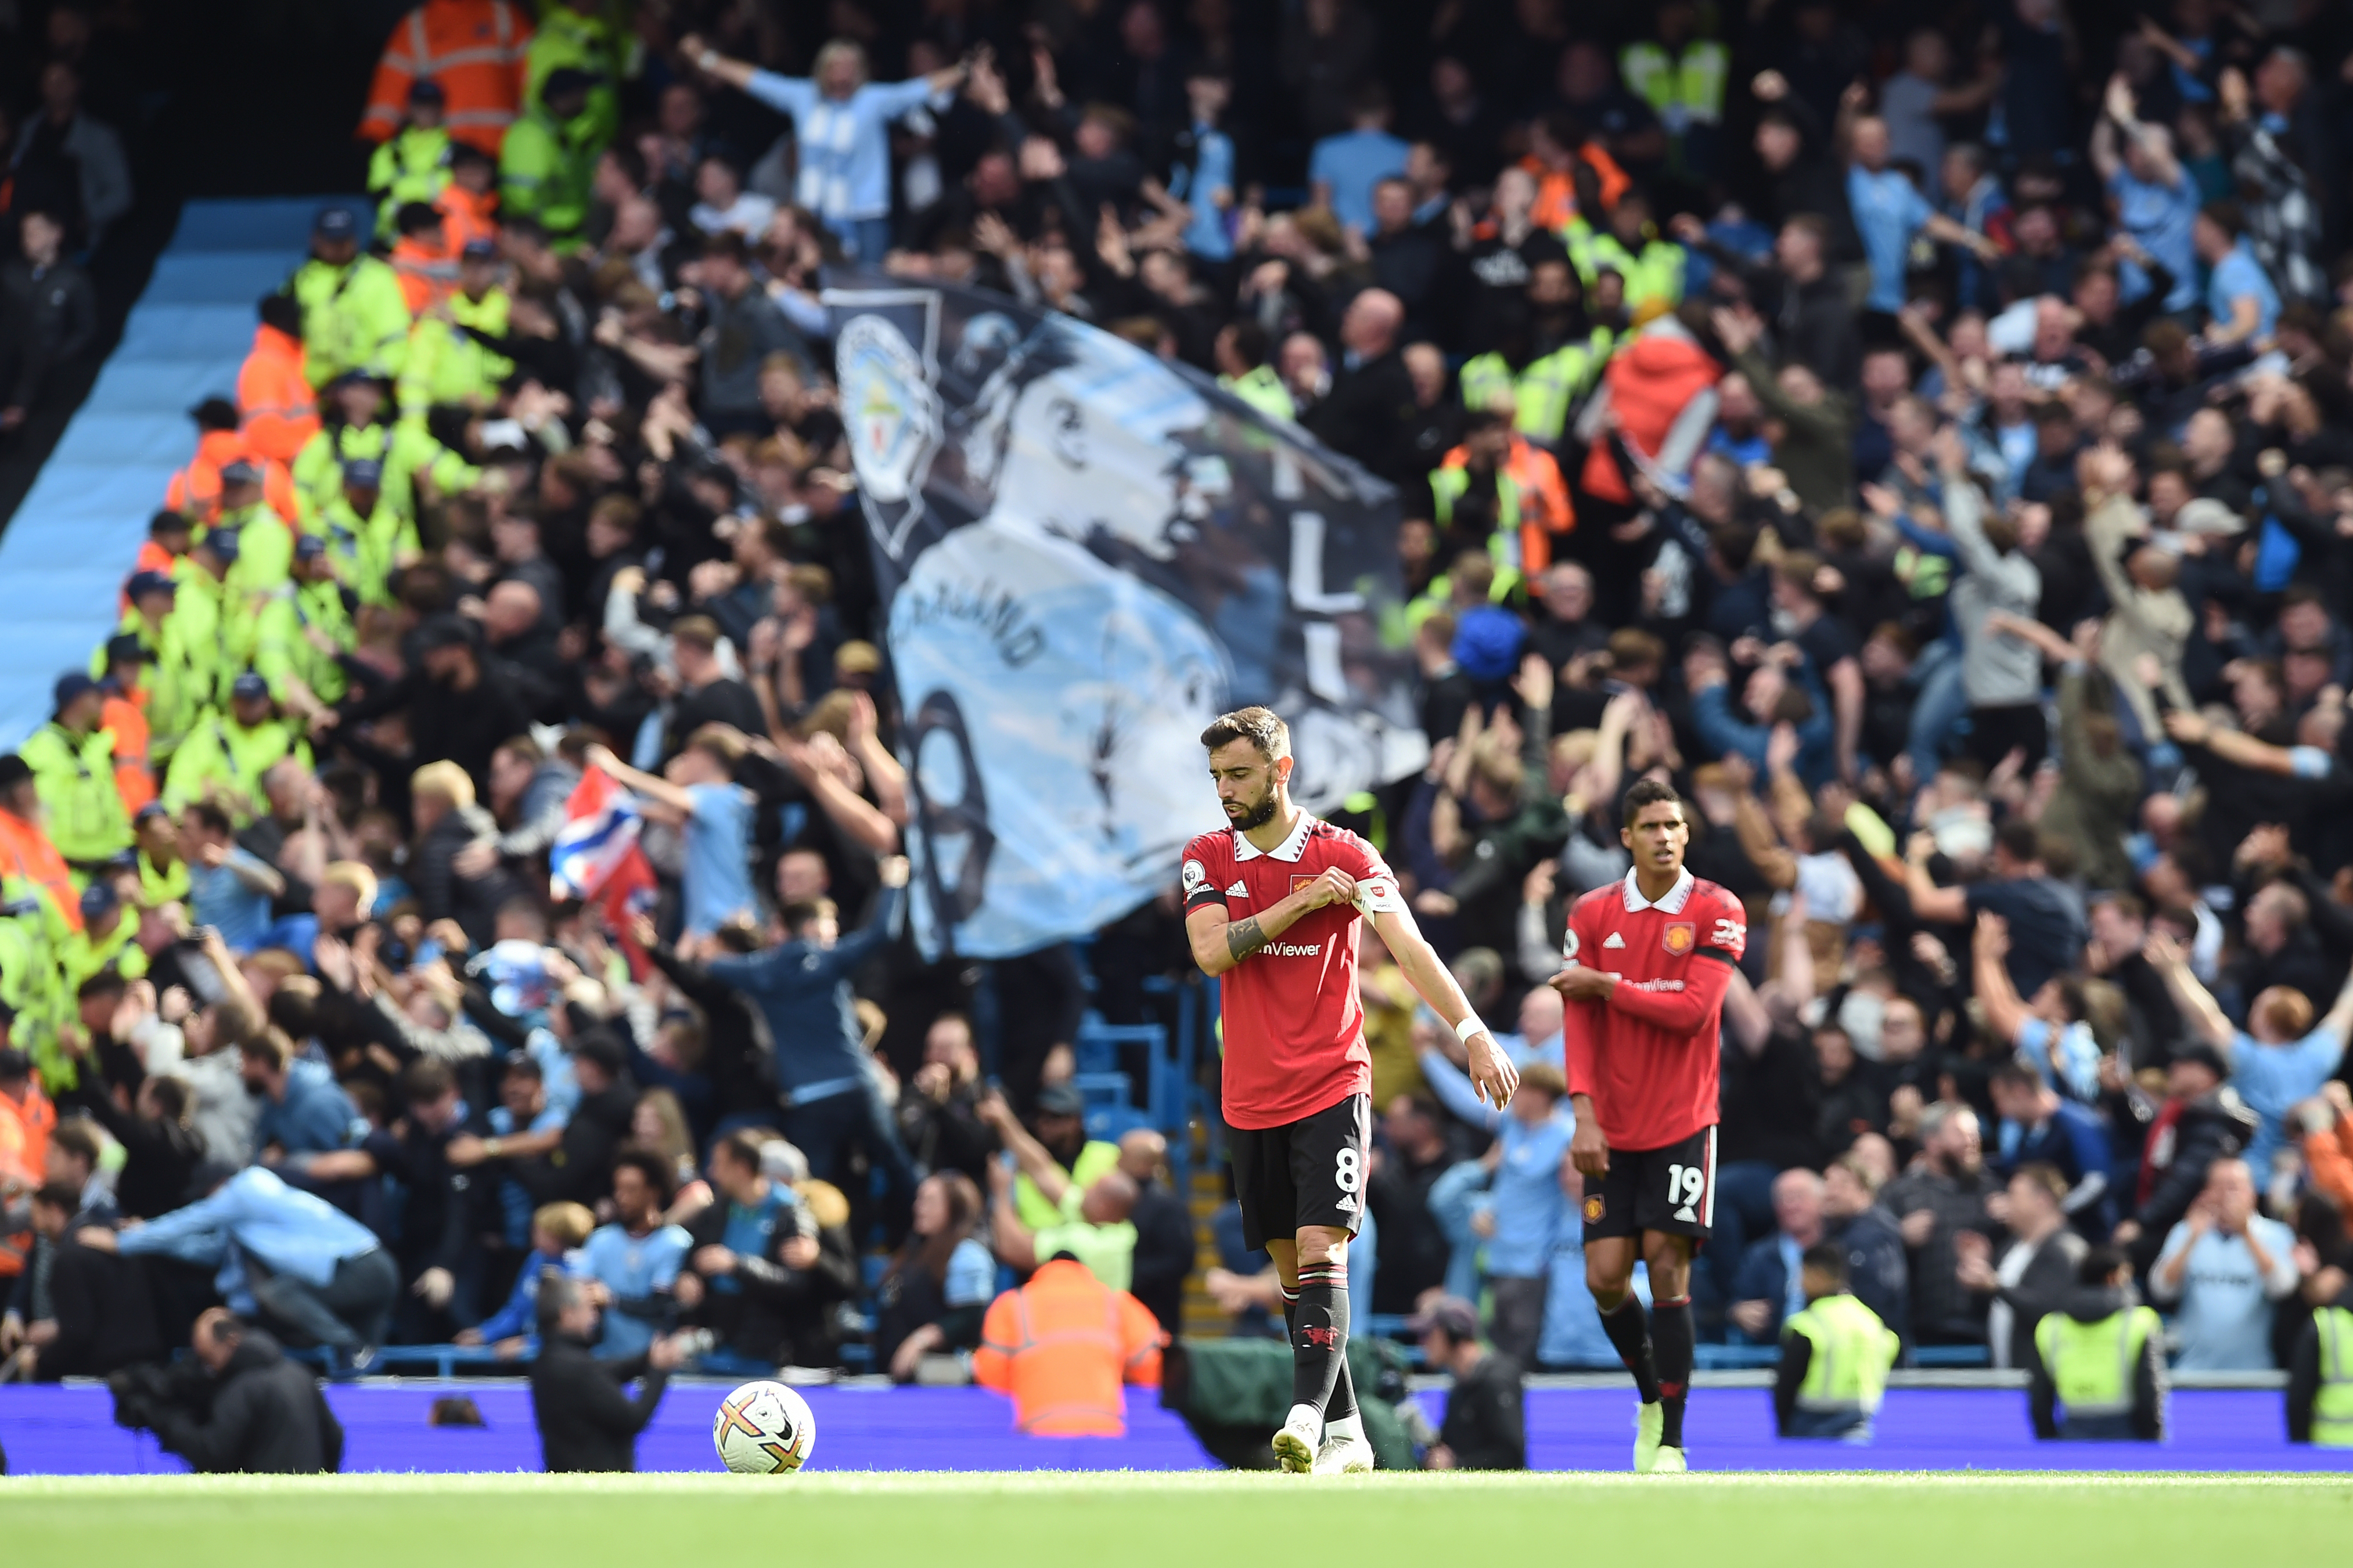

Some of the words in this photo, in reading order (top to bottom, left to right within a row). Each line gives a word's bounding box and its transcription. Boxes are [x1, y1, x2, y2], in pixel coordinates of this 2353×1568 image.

[1225, 889, 1249, 898] adidas
[1258, 942, 1321, 956] mViewer
[1336, 1147, 1361, 1192] 8
[1668, 1164, 1705, 1206] 19
